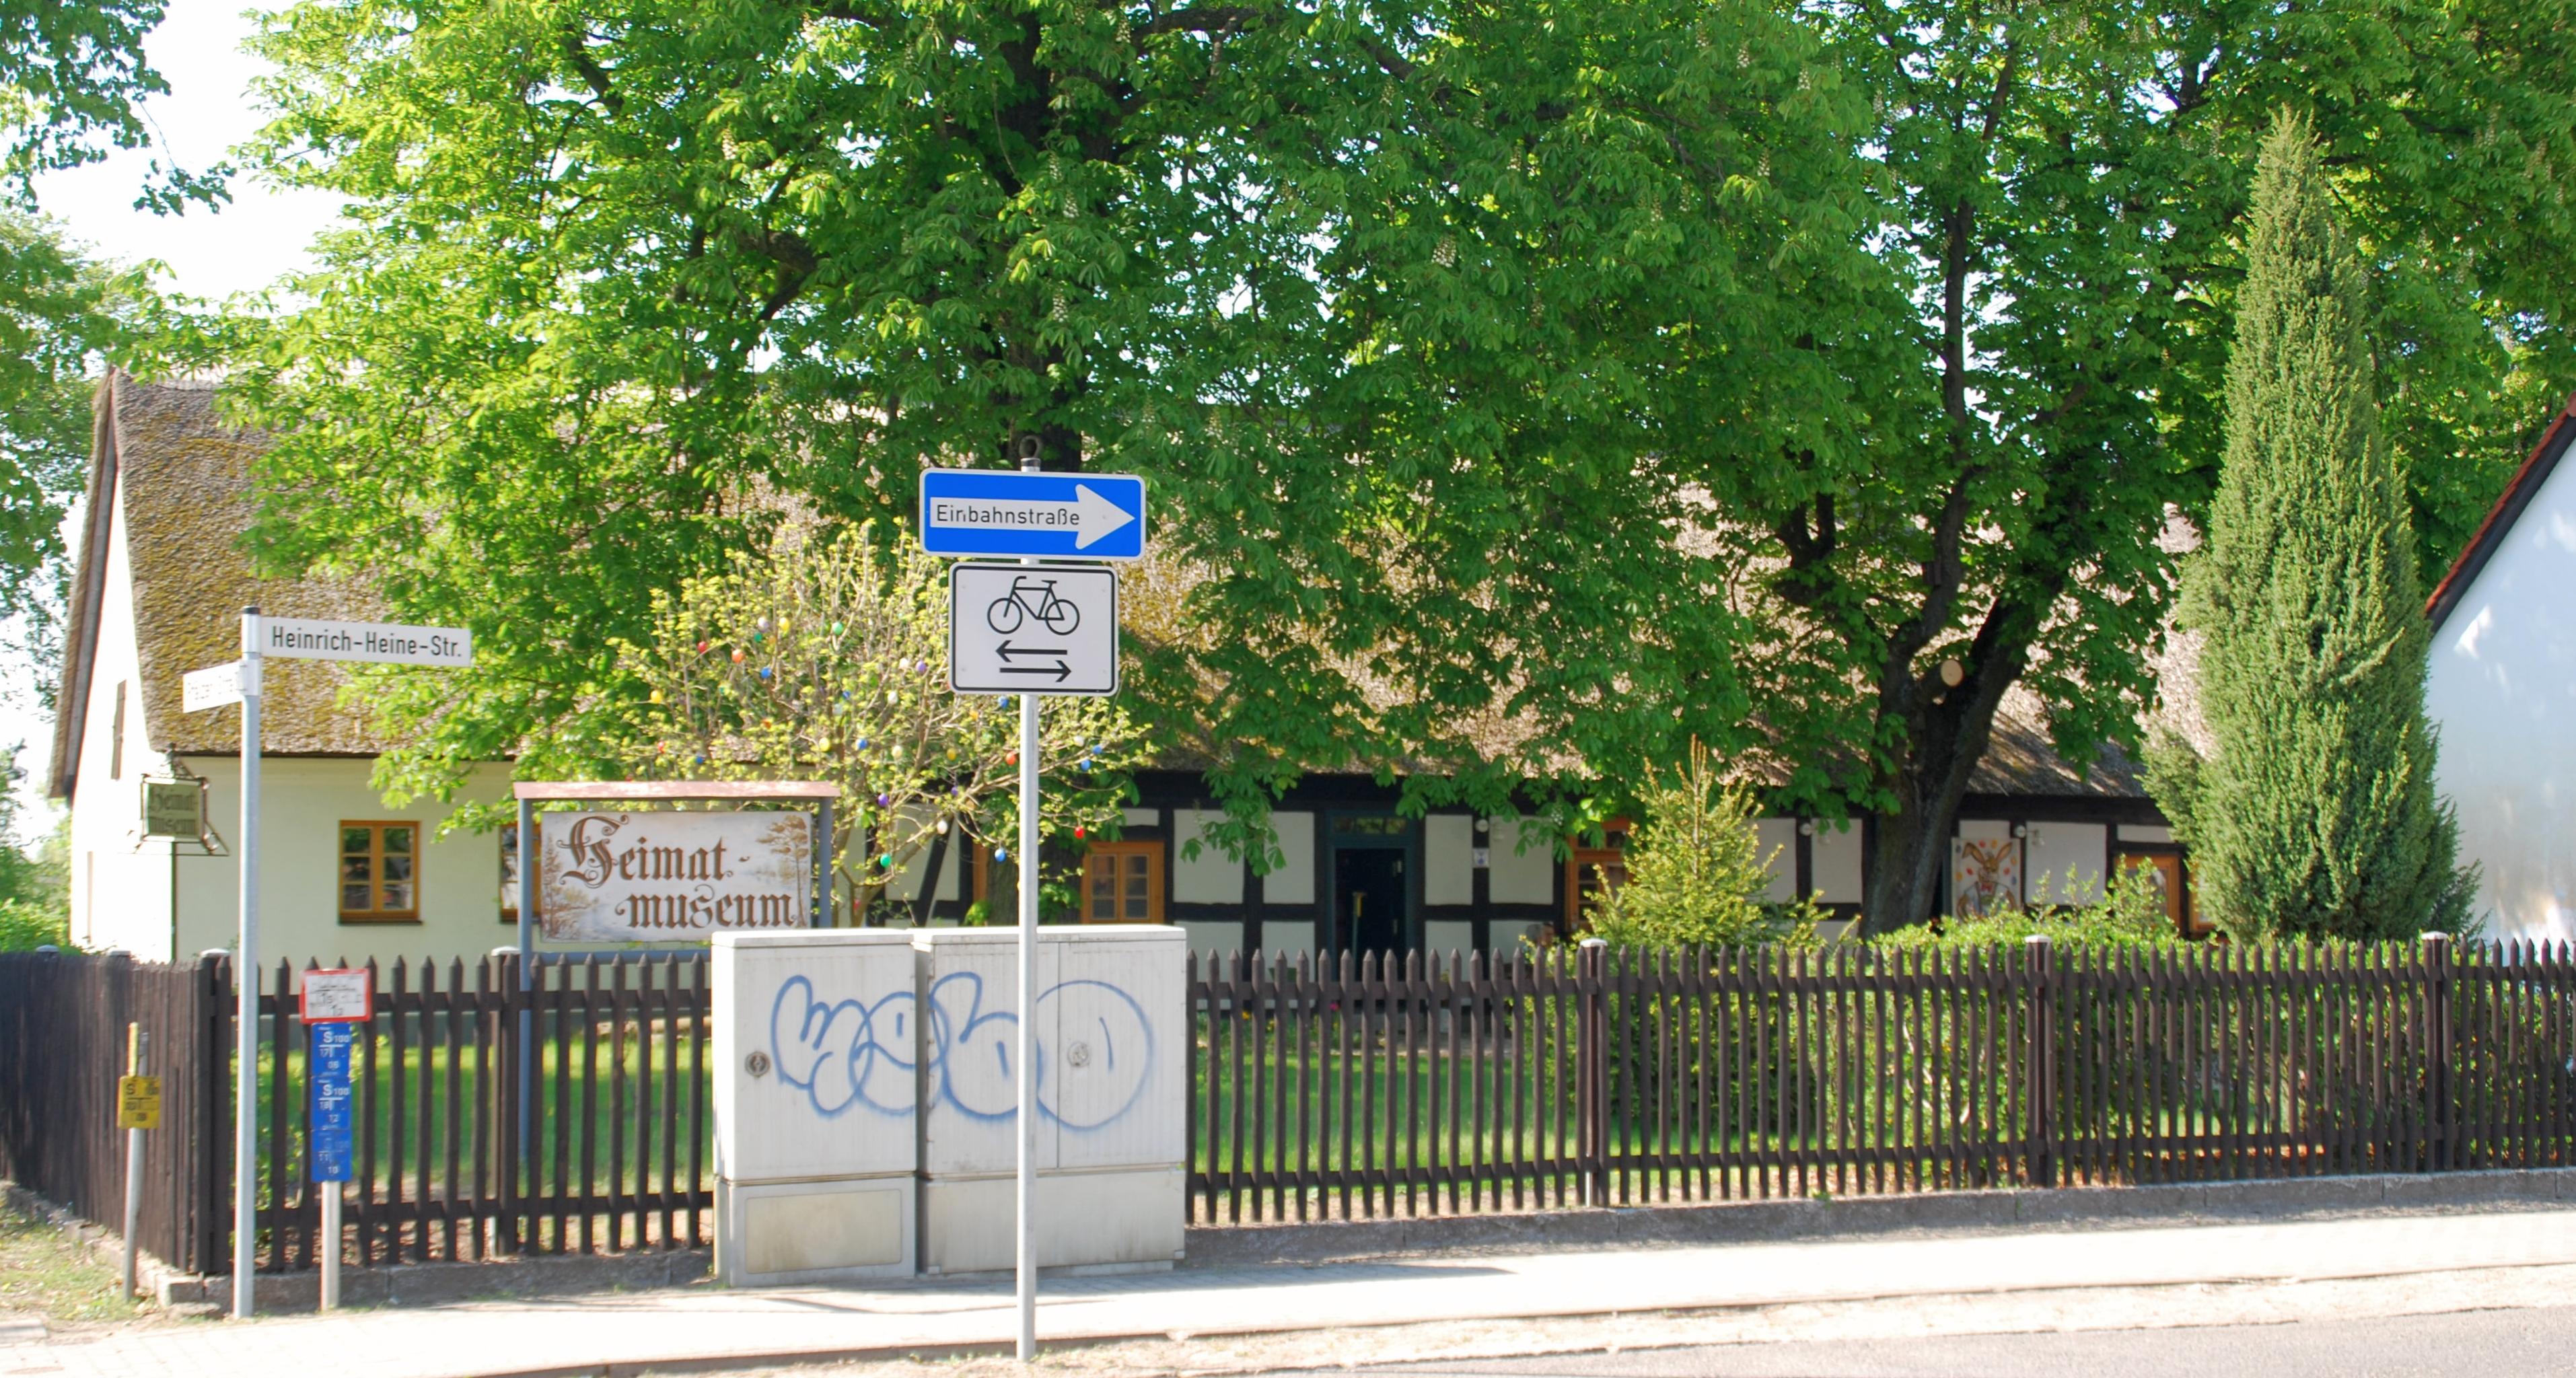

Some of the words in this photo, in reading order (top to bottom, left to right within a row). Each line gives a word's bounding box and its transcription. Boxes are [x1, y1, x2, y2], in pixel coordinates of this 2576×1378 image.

[937, 505, 1080, 525] Einbahnstraße
[272, 626, 462, 657] Heinrich-Heine-Str.
[614, 884, 797, 929] museum
